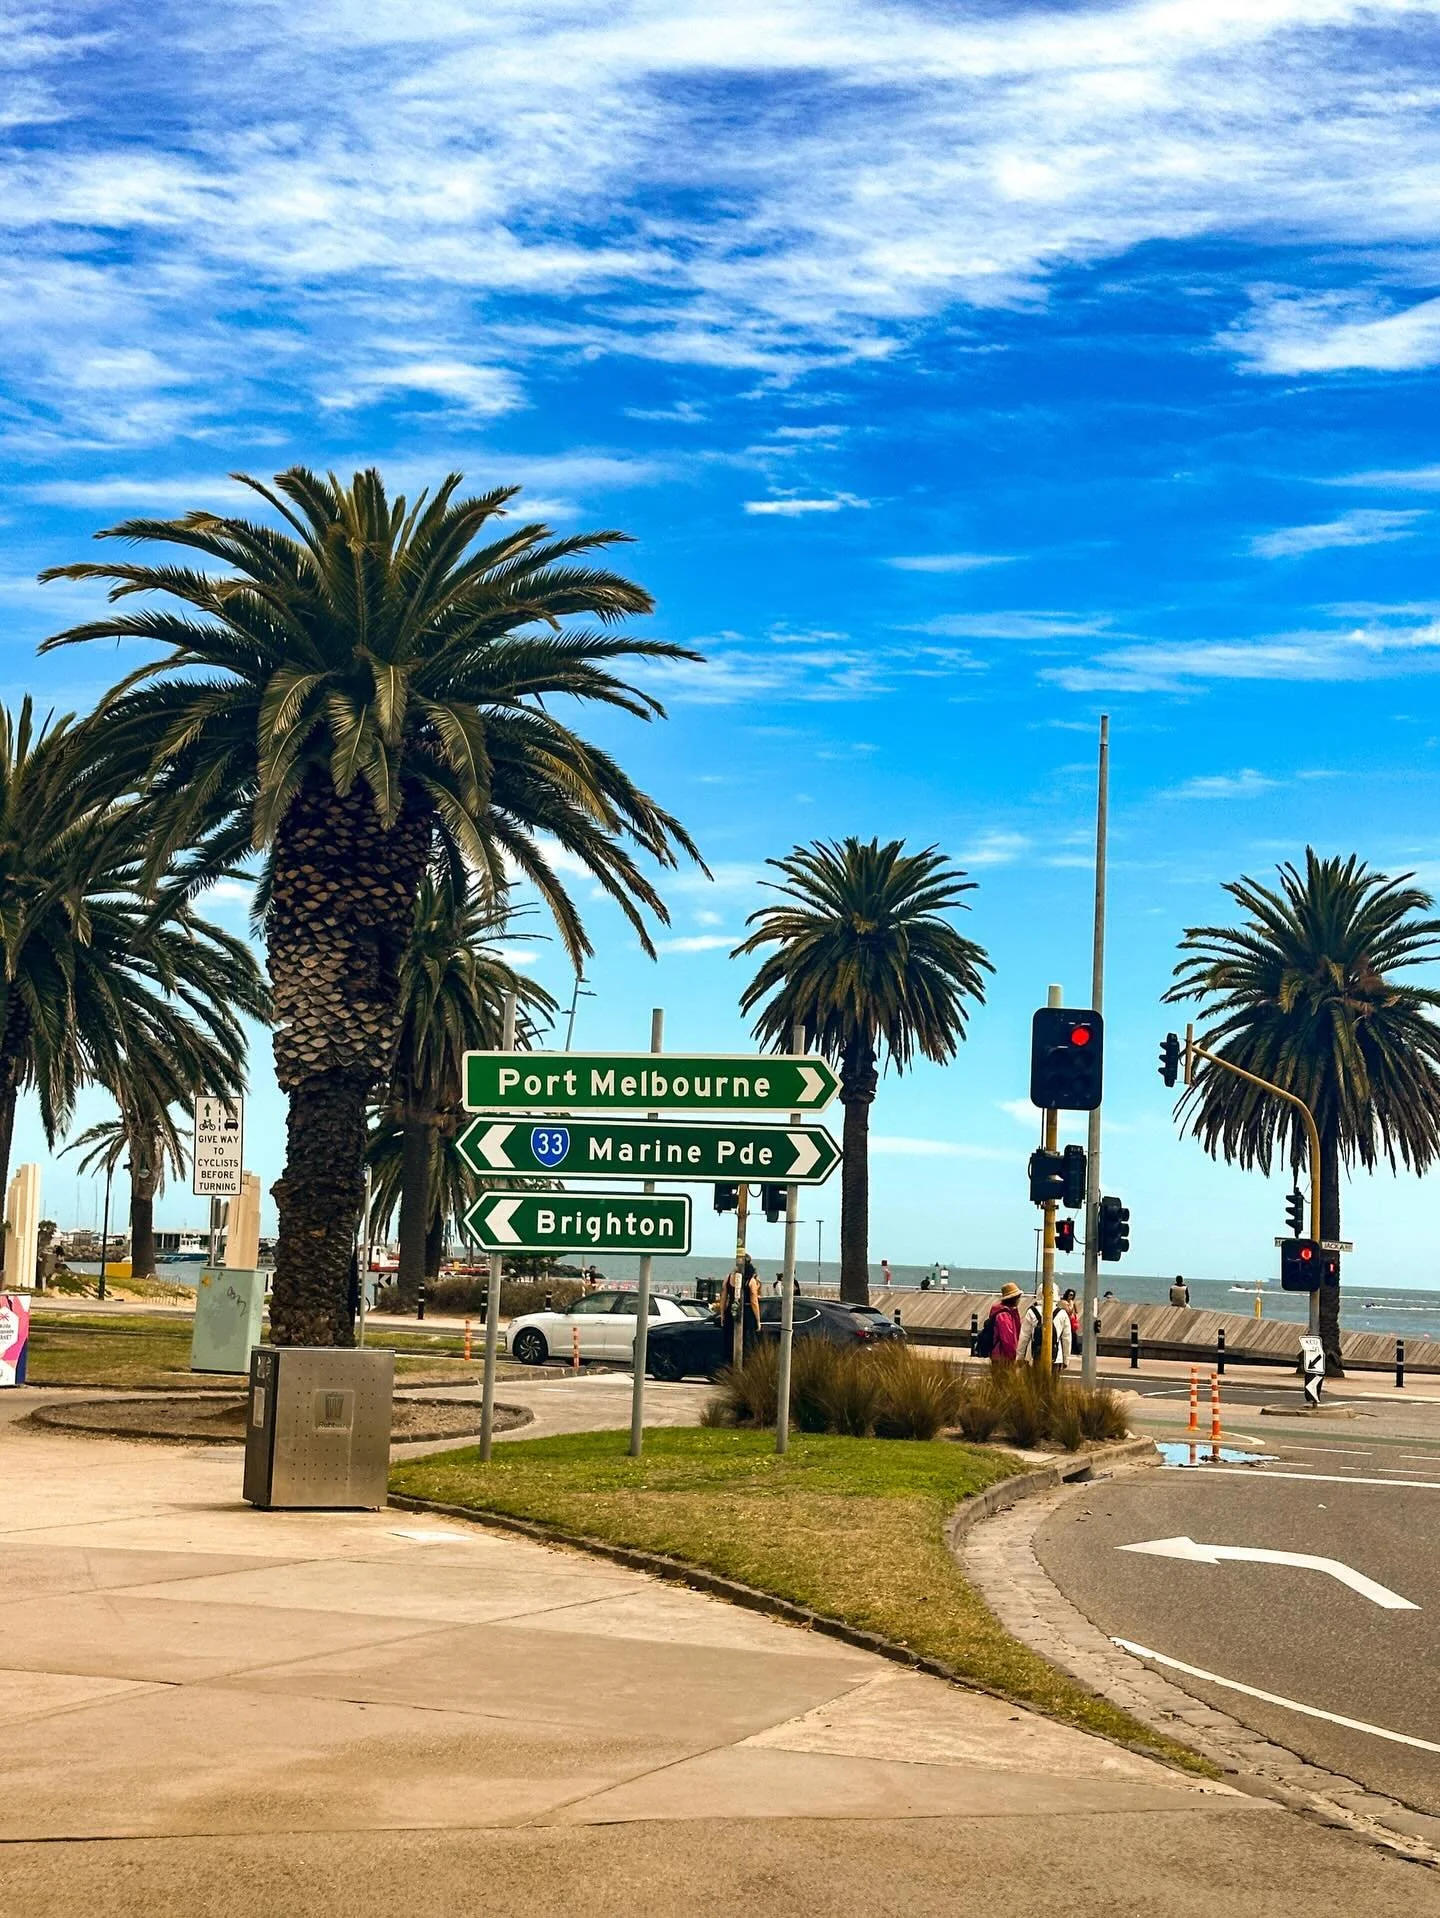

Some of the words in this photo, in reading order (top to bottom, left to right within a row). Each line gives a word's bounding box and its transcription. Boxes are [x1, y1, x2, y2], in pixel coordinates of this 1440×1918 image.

[498, 1068, 577, 1096] Port
[590, 1070, 771, 1098] Melbourne
[198, 1135, 218, 1144] GIVE
[220, 1135, 239, 1144] WAY
[537, 1132, 564, 1156] 33
[213, 1147, 225, 1156] TO
[589, 1137, 703, 1163] Marine
[717, 1141, 774, 1165] Pde
[197, 1159, 239, 1168] CYCLISTS
[201, 1170, 234, 1179] BEFORE
[199, 1182, 237, 1191] TURNING
[537, 1209, 674, 1243] Brighton
